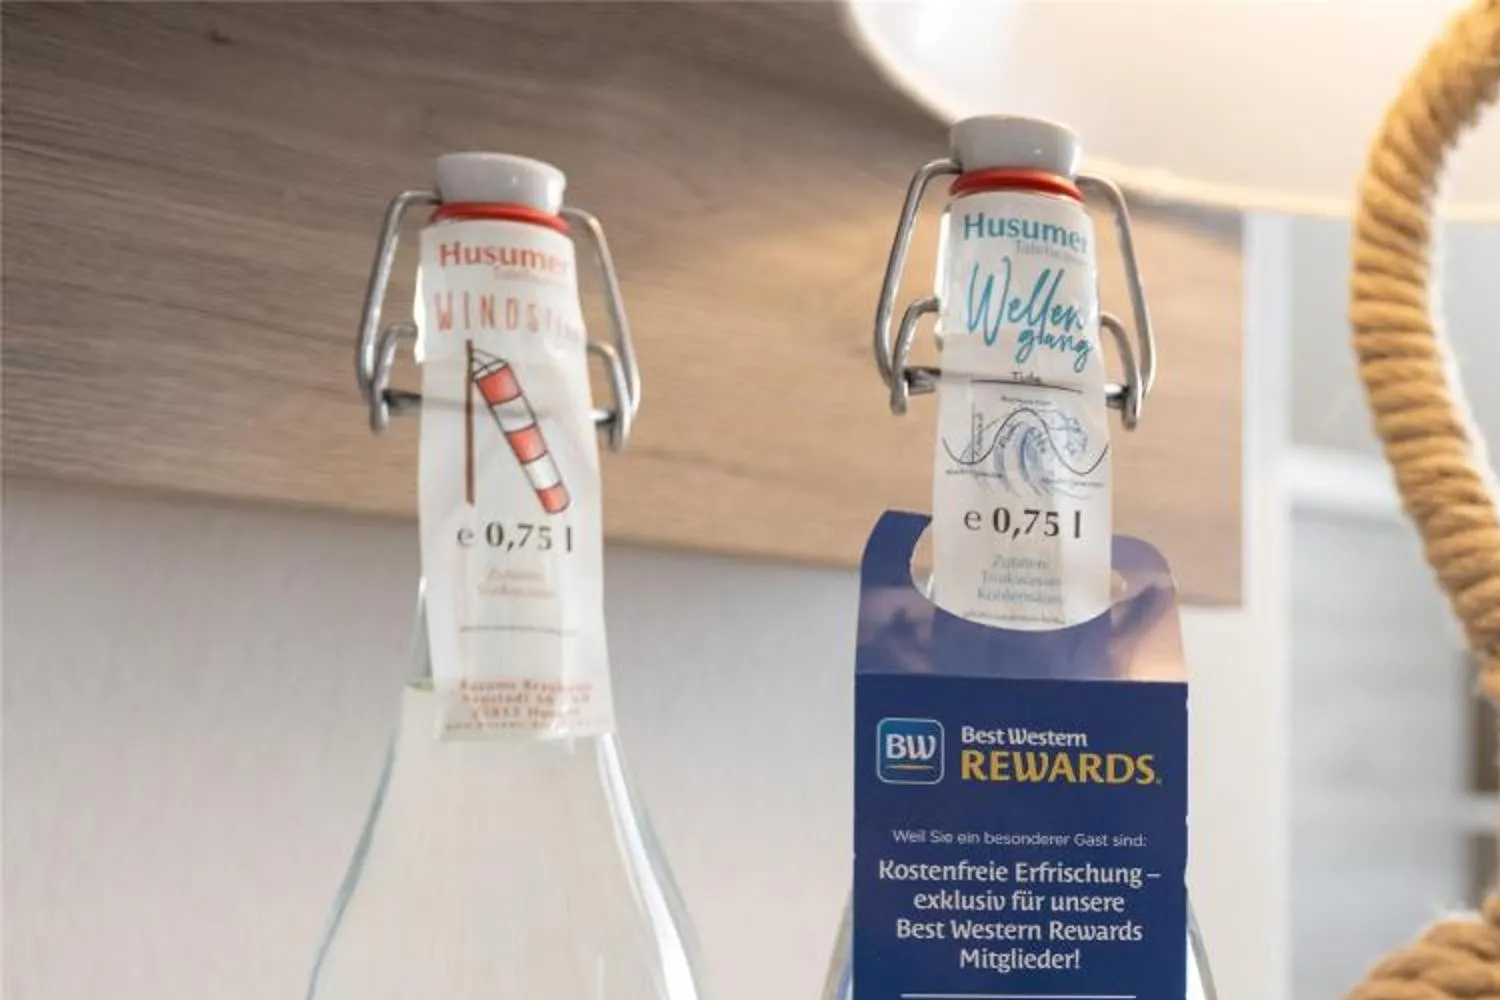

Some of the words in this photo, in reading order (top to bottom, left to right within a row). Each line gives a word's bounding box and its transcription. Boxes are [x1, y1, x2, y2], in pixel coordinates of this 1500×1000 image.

[963, 211, 1087, 254] Husumer
[966, 255, 1084, 346] Wellen
[485, 521, 553, 552] 0,75
[993, 506, 1060, 541] 0,75
[885, 733, 936, 760] BW
[961, 725, 1004, 745] Best
[1007, 728, 1088, 748] Western
[960, 749, 1155, 786] REWARDS
[892, 829, 926, 844] Weil
[931, 830, 954, 844] Sie
[957, 831, 980, 845] ein
[984, 831, 1071, 848] besonderer
[1074, 833, 1108, 848] Gast
[1112, 834, 1148, 848] sind:
[879, 859, 1009, 882] Kostenfreie
[913, 890, 1006, 912] exklusiv
[1011, 890, 1045, 912] für
[1051, 894, 1125, 913] unsere
[896, 919, 945, 940] Best
[949, 920, 1041, 941] Western
[1049, 920, 1144, 942] Rewards
[959, 948, 1081, 974] Mitglieder!
